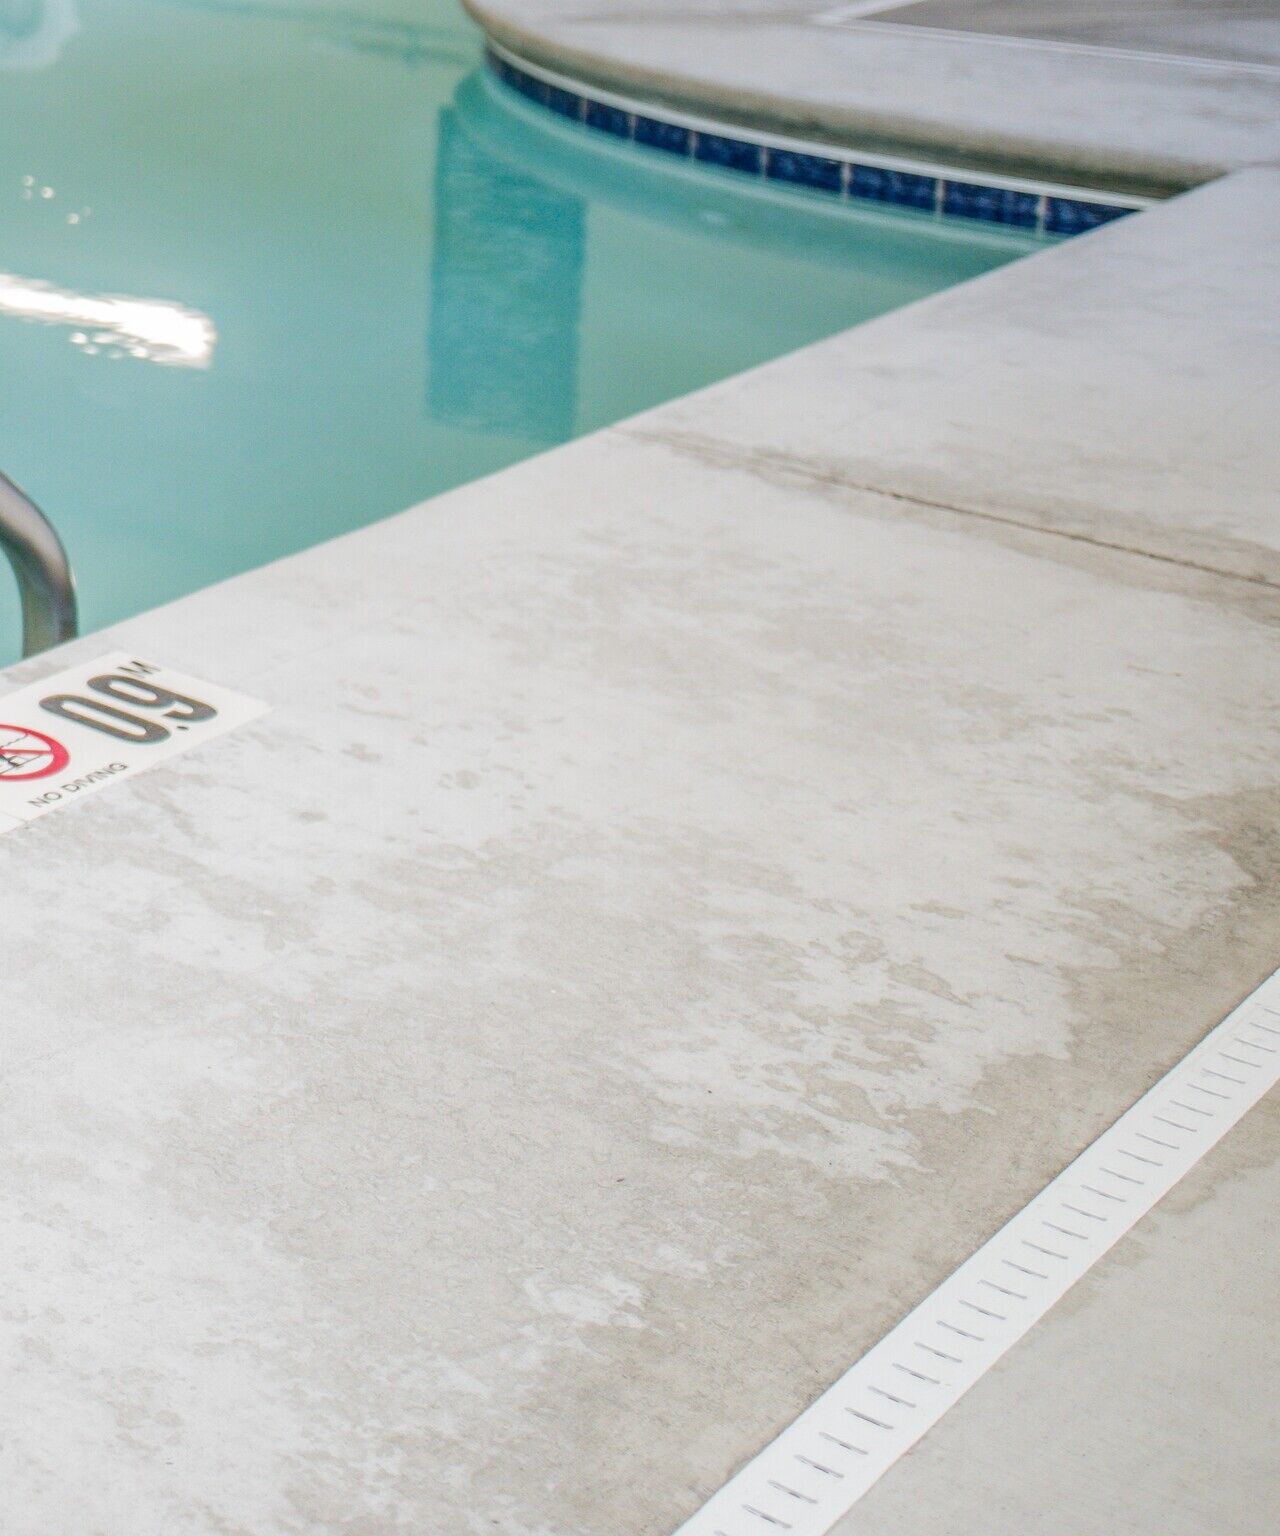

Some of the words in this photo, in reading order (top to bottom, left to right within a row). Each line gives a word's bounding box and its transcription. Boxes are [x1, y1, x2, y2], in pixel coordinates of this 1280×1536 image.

[116, 660, 161, 680] M
[28, 790, 62, 808] NO
[61, 761, 130, 793] DIVING
